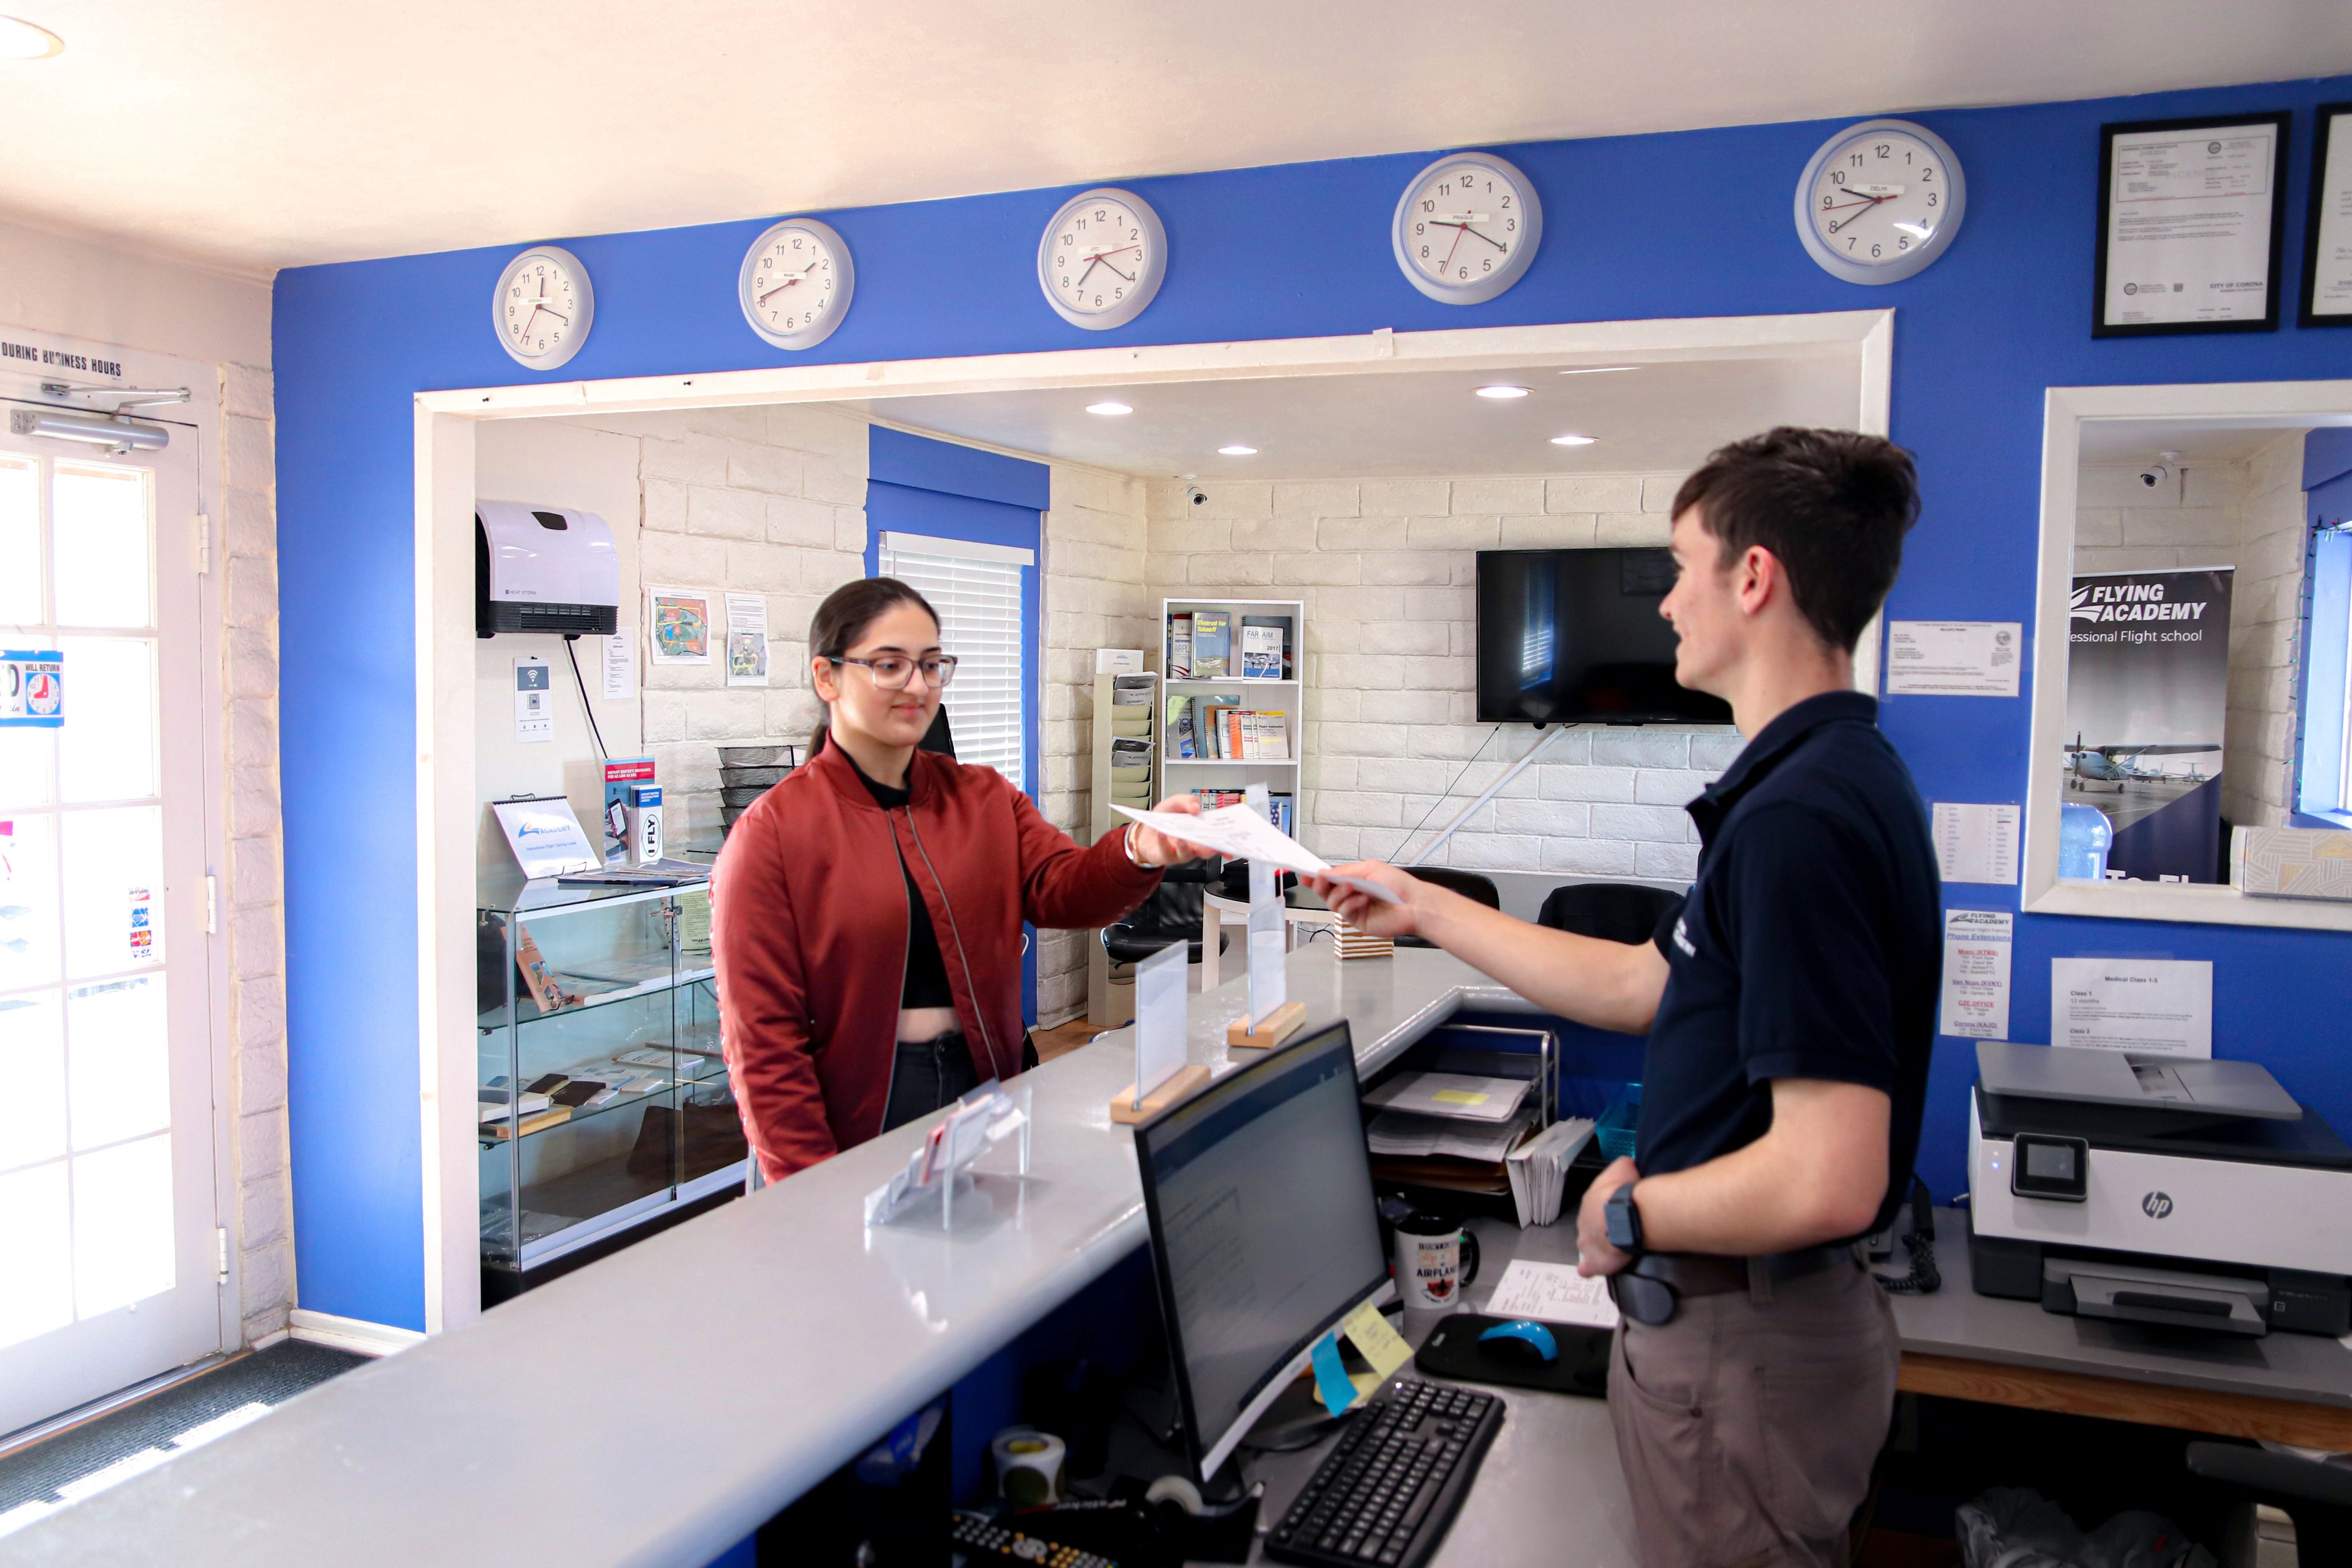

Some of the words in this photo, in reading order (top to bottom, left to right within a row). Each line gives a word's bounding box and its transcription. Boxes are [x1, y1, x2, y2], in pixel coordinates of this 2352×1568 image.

[1875, 146, 1890, 158] 12
[1850, 154, 1862, 167] 11
[1906, 152, 1910, 164] 1
[1831, 171, 1845, 184] 10
[1922, 168, 1932, 181] 2
[1460, 176, 1473, 188] 12
[1487, 182, 1491, 193] 1
[1439, 184, 1449, 196] 11
[1502, 196, 1510, 208] 2
[1824, 196, 1832, 209] 9
[1928, 193, 1937, 206] 3
[1422, 200, 1434, 212] 10
[1094, 211, 1105, 221] 12
[1117, 216, 1121, 226] 1
[1076, 219, 1086, 230] 11
[1416, 223, 1424, 235] 9
[1507, 219, 1515, 230] 3
[1829, 221, 1838, 233] 8
[1919, 218, 1927, 229] 4
[1062, 234, 1073, 245] 10
[1131, 229, 1137, 240] 2
[792, 239, 802, 249] 12
[1500, 243, 1507, 254] 4
[1848, 238, 1857, 250] 7
[1899, 237, 1908, 249] 5
[776, 245, 784, 255] 11
[812, 246, 816, 255] 1
[1136, 250, 1142, 260] 3
[1422, 245, 1429, 257] 8
[1872, 245, 1880, 257] 6
[763, 258, 772, 268] 10
[822, 259, 828, 269] 2
[1058, 256, 1064, 267] 9
[1439, 261, 1446, 272] 7
[1483, 259, 1491, 271] 5
[536, 266, 544, 276] 12
[553, 270, 556, 279] 1
[1459, 267, 1467, 278] 6
[522, 274, 529, 283] 11
[758, 277, 763, 287] 9
[1063, 277, 1069, 287] 8
[1129, 272, 1135, 282] 4
[564, 281, 569, 291] 2
[825, 279, 830, 289] 3
[512, 287, 520, 297] 10
[1078, 290, 1084, 301] 7
[1116, 288, 1122, 299] 5
[568, 299, 572, 309] 3
[760, 297, 766, 307] 8
[818, 299, 824, 309] 4
[1095, 295, 1102, 306] 6
[509, 307, 514, 316] 9
[772, 312, 777, 321] 7
[787, 317, 793, 328] 6
[805, 313, 811, 322] 5
[514, 324, 519, 334] 8
[525, 336, 529, 345] 7
[554, 333, 559, 342] 5
[539, 340, 544, 349] 6
[2, 342, 38, 361] DURING
[43, 350, 87, 370] BUSINESS
[92, 359, 121, 376] HOURS
[2092, 584, 2164, 603] FLYING
[2100, 602, 2207, 622] ACADEMY
[2121, 631, 2157, 644] Flight
[2161, 630, 2202, 642] school
[541, 825, 570, 834] ACADEMY
[2146, 1191, 2169, 1219] hp
